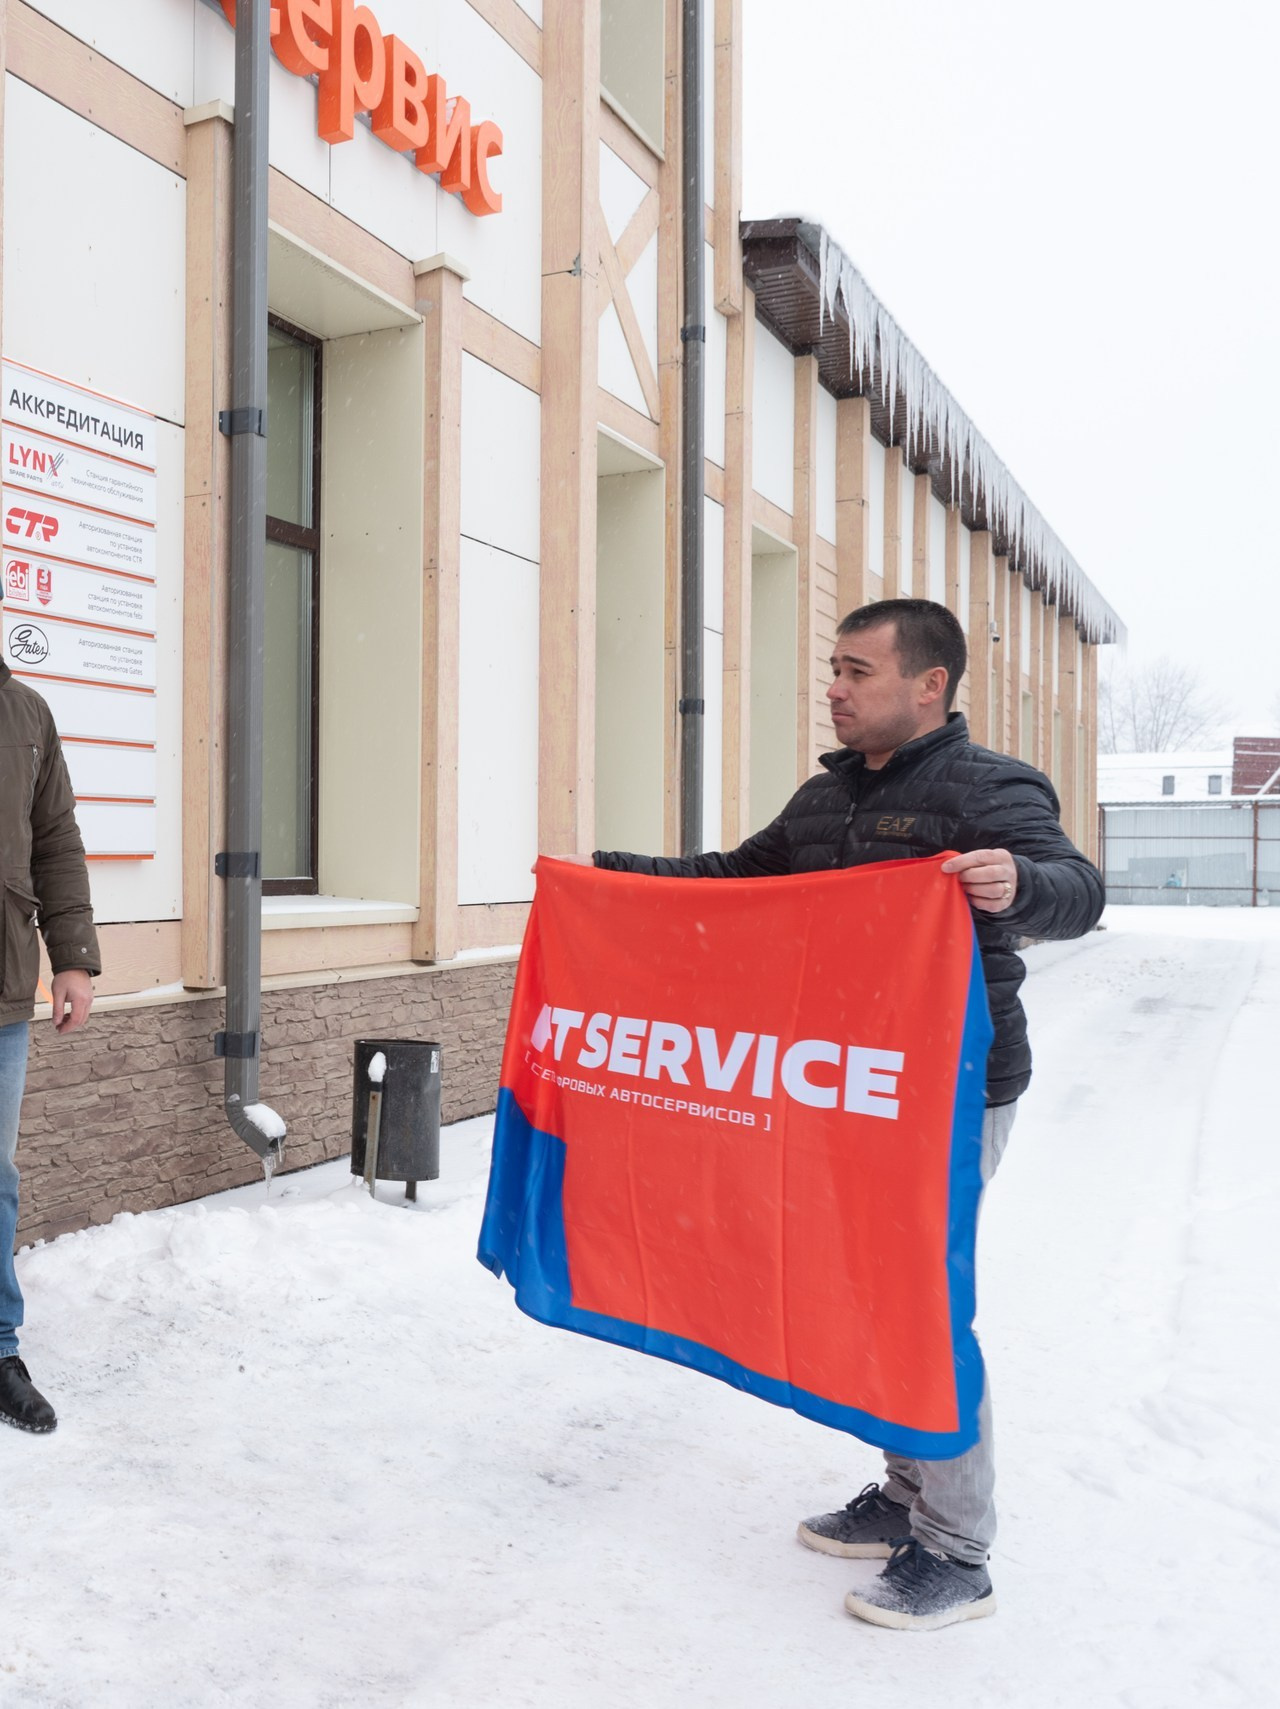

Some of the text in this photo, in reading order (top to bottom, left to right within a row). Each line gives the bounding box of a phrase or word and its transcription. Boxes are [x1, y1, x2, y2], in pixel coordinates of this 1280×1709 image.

[220, 0, 503, 217] ервис
[9, 388, 144, 451] АККРЕДИТАЦИЯ
[9, 443, 65, 477] LYNX
[6, 507, 59, 542] CTR
[6, 560, 29, 590] febi
[10, 629, 48, 657] Gates
[609, 1086, 756, 1127] АВТОСЕРВИСОВ
